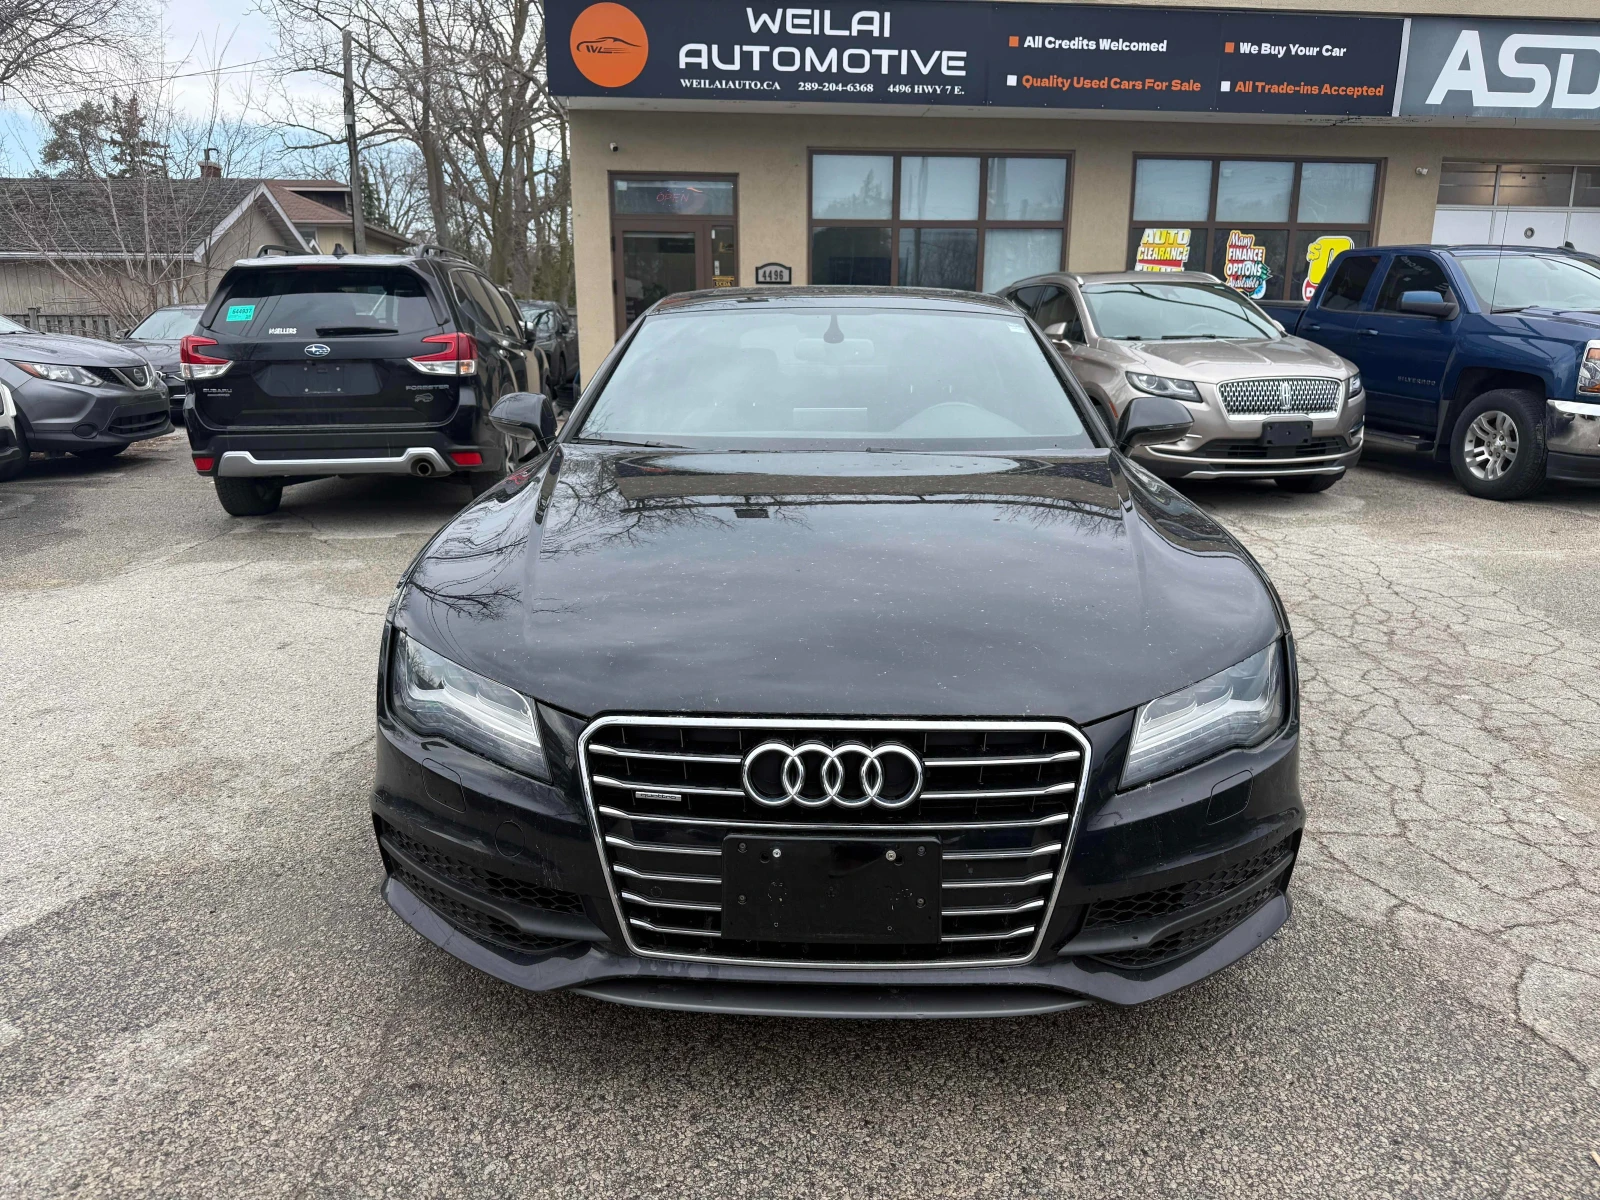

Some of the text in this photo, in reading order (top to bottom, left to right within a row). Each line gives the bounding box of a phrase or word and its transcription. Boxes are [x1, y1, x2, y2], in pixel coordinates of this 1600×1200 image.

[746, 7, 891, 38] WEILAI
[1024, 36, 1167, 52] All Credits Welcomed
[1240, 42, 1347, 58] We Buy Your Car
[679, 43, 967, 76] AUTOMOTIVE
[680, 79, 781, 90] WEILAIAUTO.CA
[798, 82, 874, 92] 289-204-6368
[887, 84, 965, 95] 4496 HWY 7 E.
[1022, 75, 1201, 92] Quality Used Cars For Sale
[1235, 81, 1385, 98] All Trade-ins Accepted
[656, 193, 690, 203] OPEN
[1141, 229, 1190, 245] AUTO
[1230, 232, 1252, 249] Many
[1138, 247, 1190, 262] CLEARANCE
[1228, 248, 1263, 261] FINANCE
[762, 269, 784, 281] 4496
[1226, 261, 1262, 276] OPTIONS
